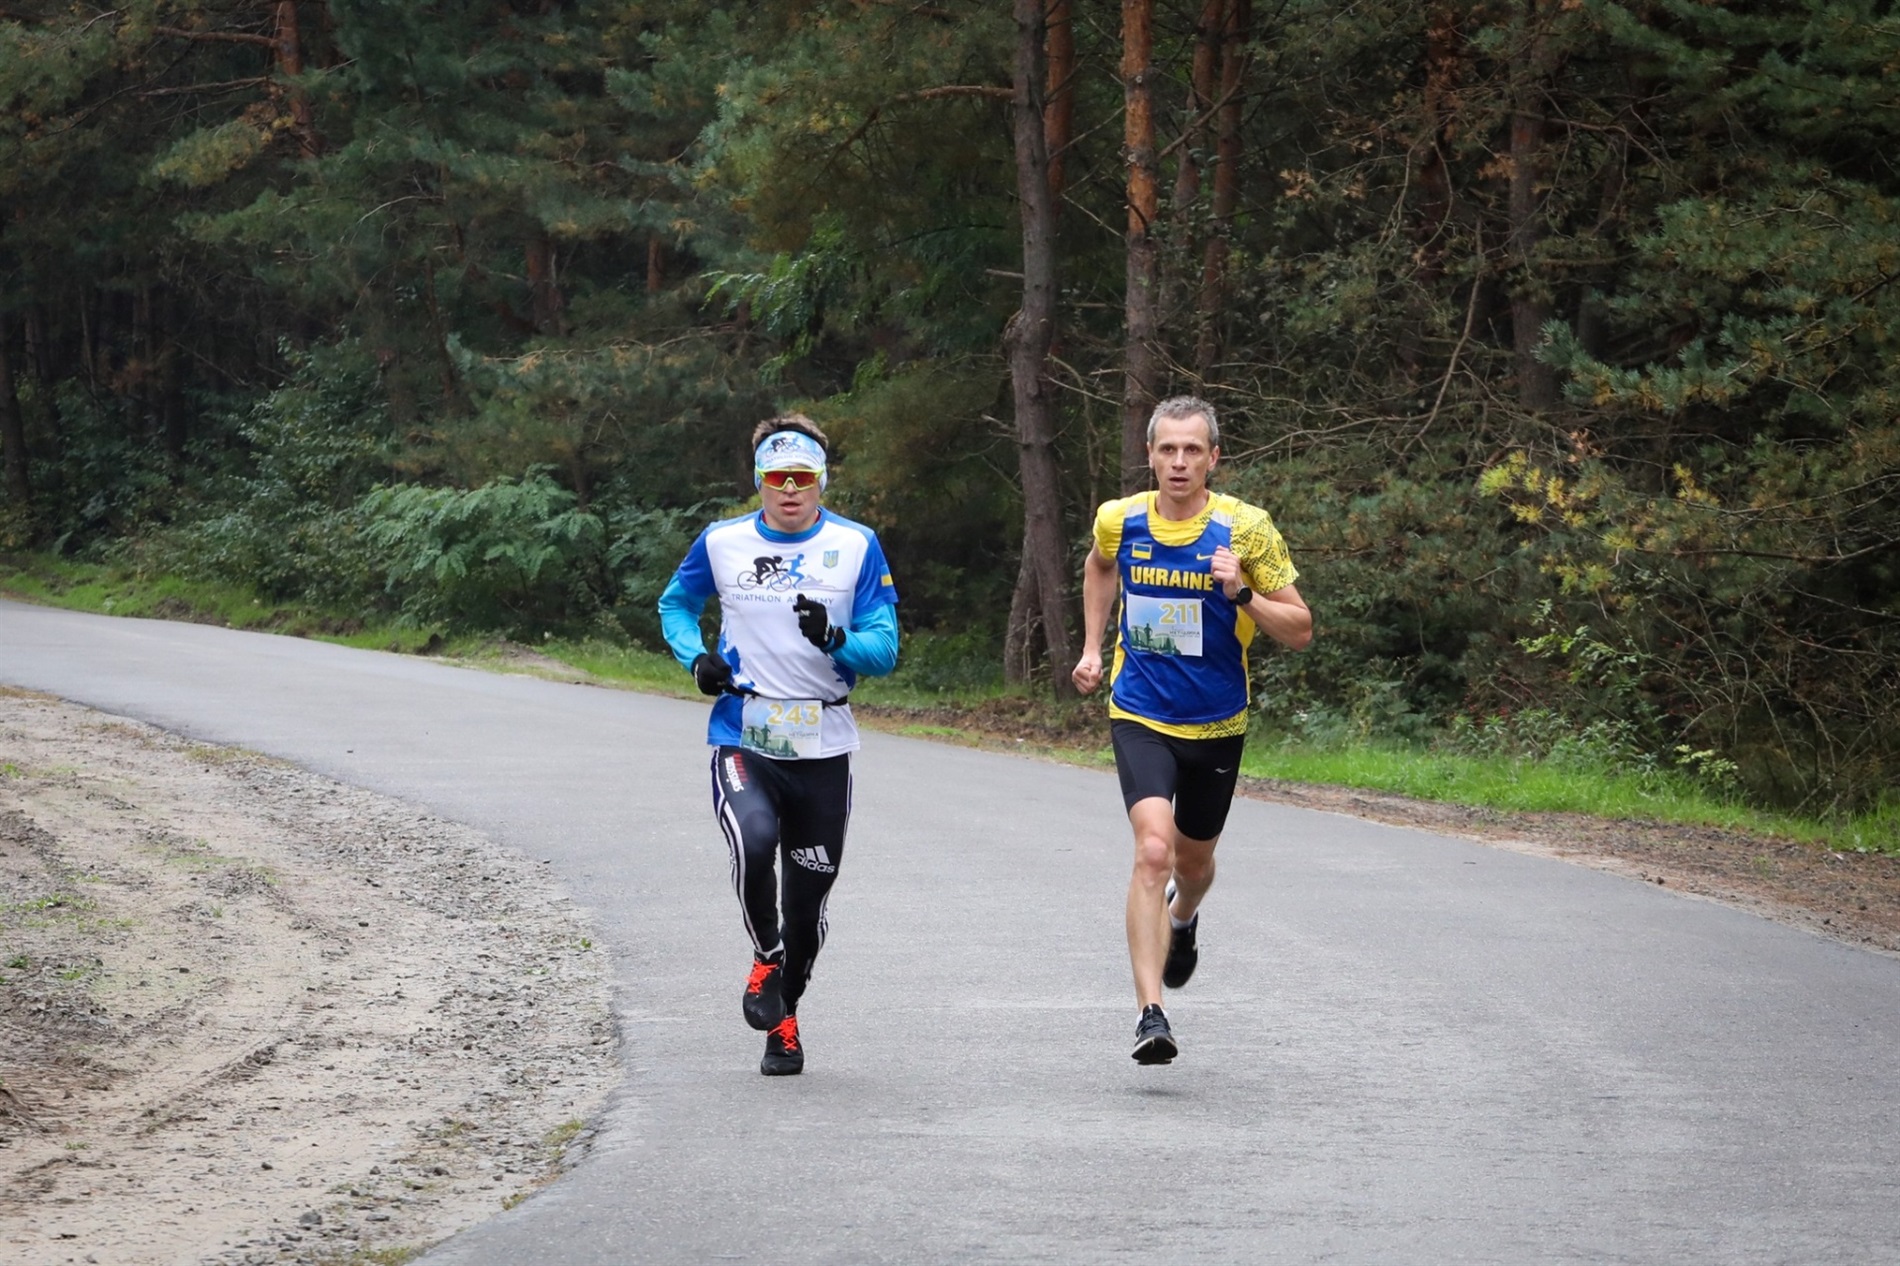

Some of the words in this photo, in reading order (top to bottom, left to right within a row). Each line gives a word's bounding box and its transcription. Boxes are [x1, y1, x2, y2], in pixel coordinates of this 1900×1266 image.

[1131, 566, 1213, 591] UKRAINE
[731, 593, 781, 603] TRIATHLON
[787, 596, 834, 606] ACDEMY
[1160, 603, 1199, 624] 211
[767, 703, 820, 726] 243
[790, 850, 836, 873] adidas
